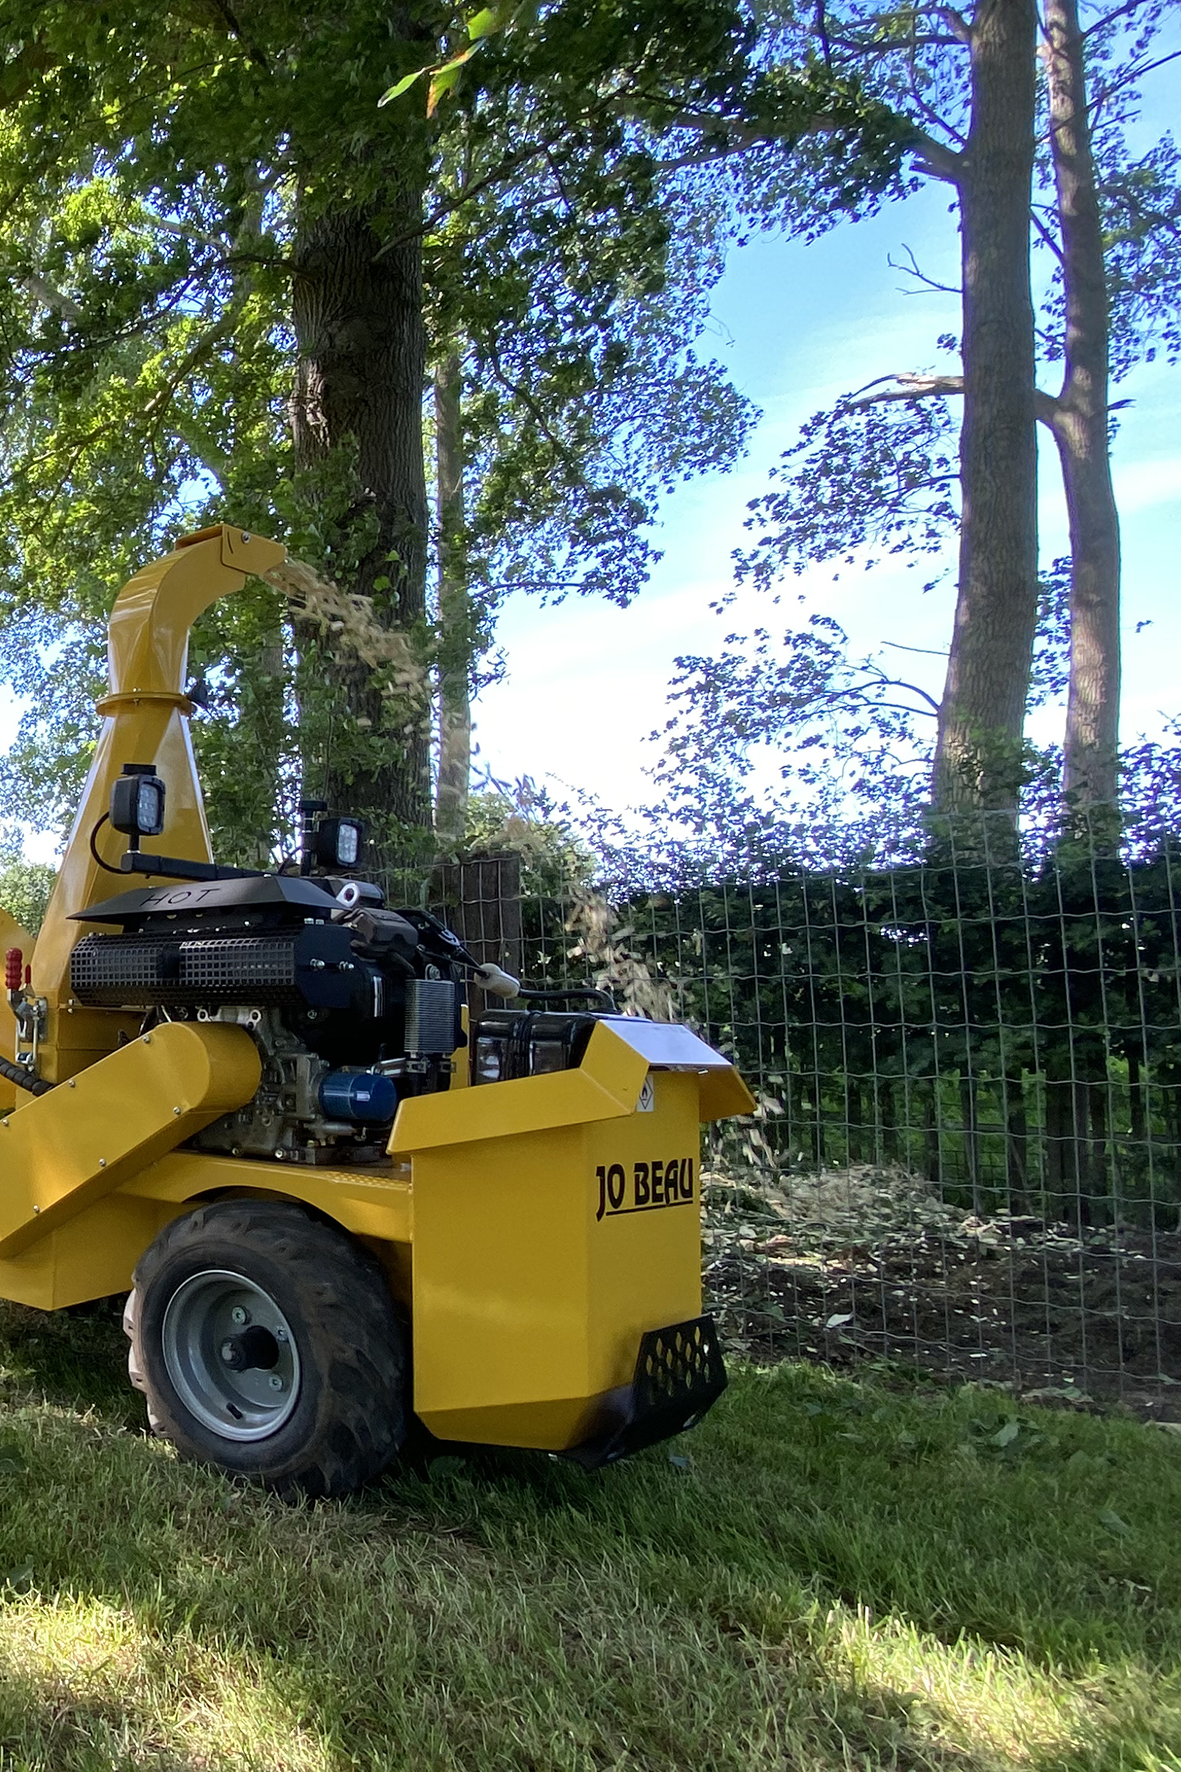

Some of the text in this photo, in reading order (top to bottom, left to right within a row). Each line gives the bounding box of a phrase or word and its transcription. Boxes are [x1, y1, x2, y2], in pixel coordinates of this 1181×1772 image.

[139, 887, 220, 907] HOT
[595, 1158, 693, 1222] JO BEAU
